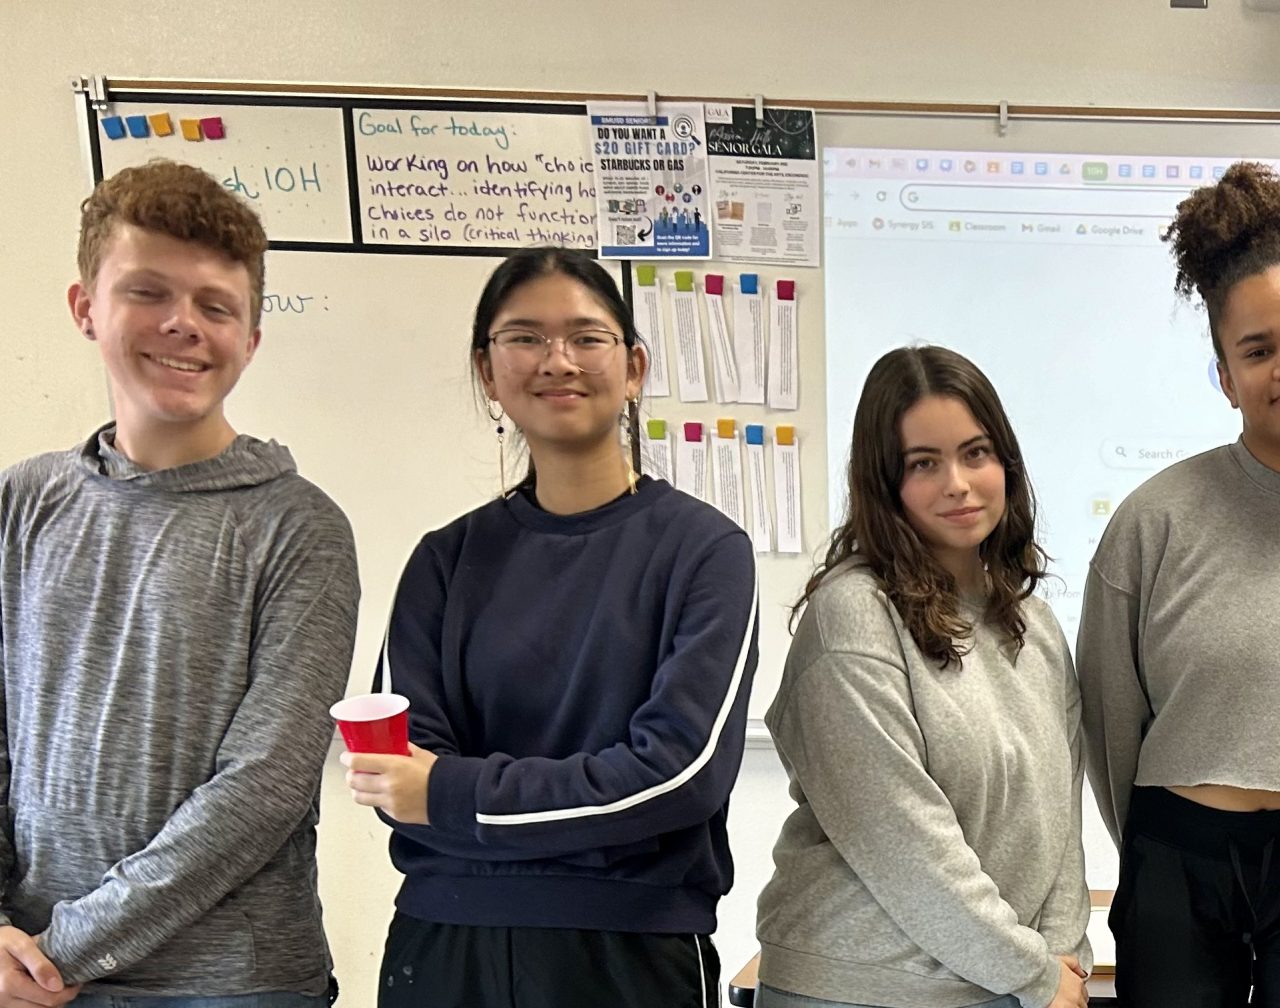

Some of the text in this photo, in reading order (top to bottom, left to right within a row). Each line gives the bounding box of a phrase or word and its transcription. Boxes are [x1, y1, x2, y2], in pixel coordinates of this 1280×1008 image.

[359, 112, 517, 150] Goal for today:
[598, 128, 666, 140] DO YOU WANT A
[595, 141, 696, 156] $20 GIFT CARD?
[708, 141, 782, 156] SENIOR GALA
[456, 161, 479, 174] on
[486, 154, 528, 174] how
[600, 159, 684, 171] STARBUCKS OR GAS
[265, 162, 321, 192] 10H
[473, 180, 573, 201] identifying
[444, 203, 467, 221] do
[475, 205, 504, 221] not
[371, 227, 388, 239] in
[399, 229, 411, 239] a
[420, 226, 451, 242] silo
[463, 223, 520, 244] (critical
[1037, 224, 1061, 233] Gmail
[1091, 226, 1144, 236] Google Drive
[262, 293, 329, 313] ow:
[1138, 449, 1173, 460] Search
